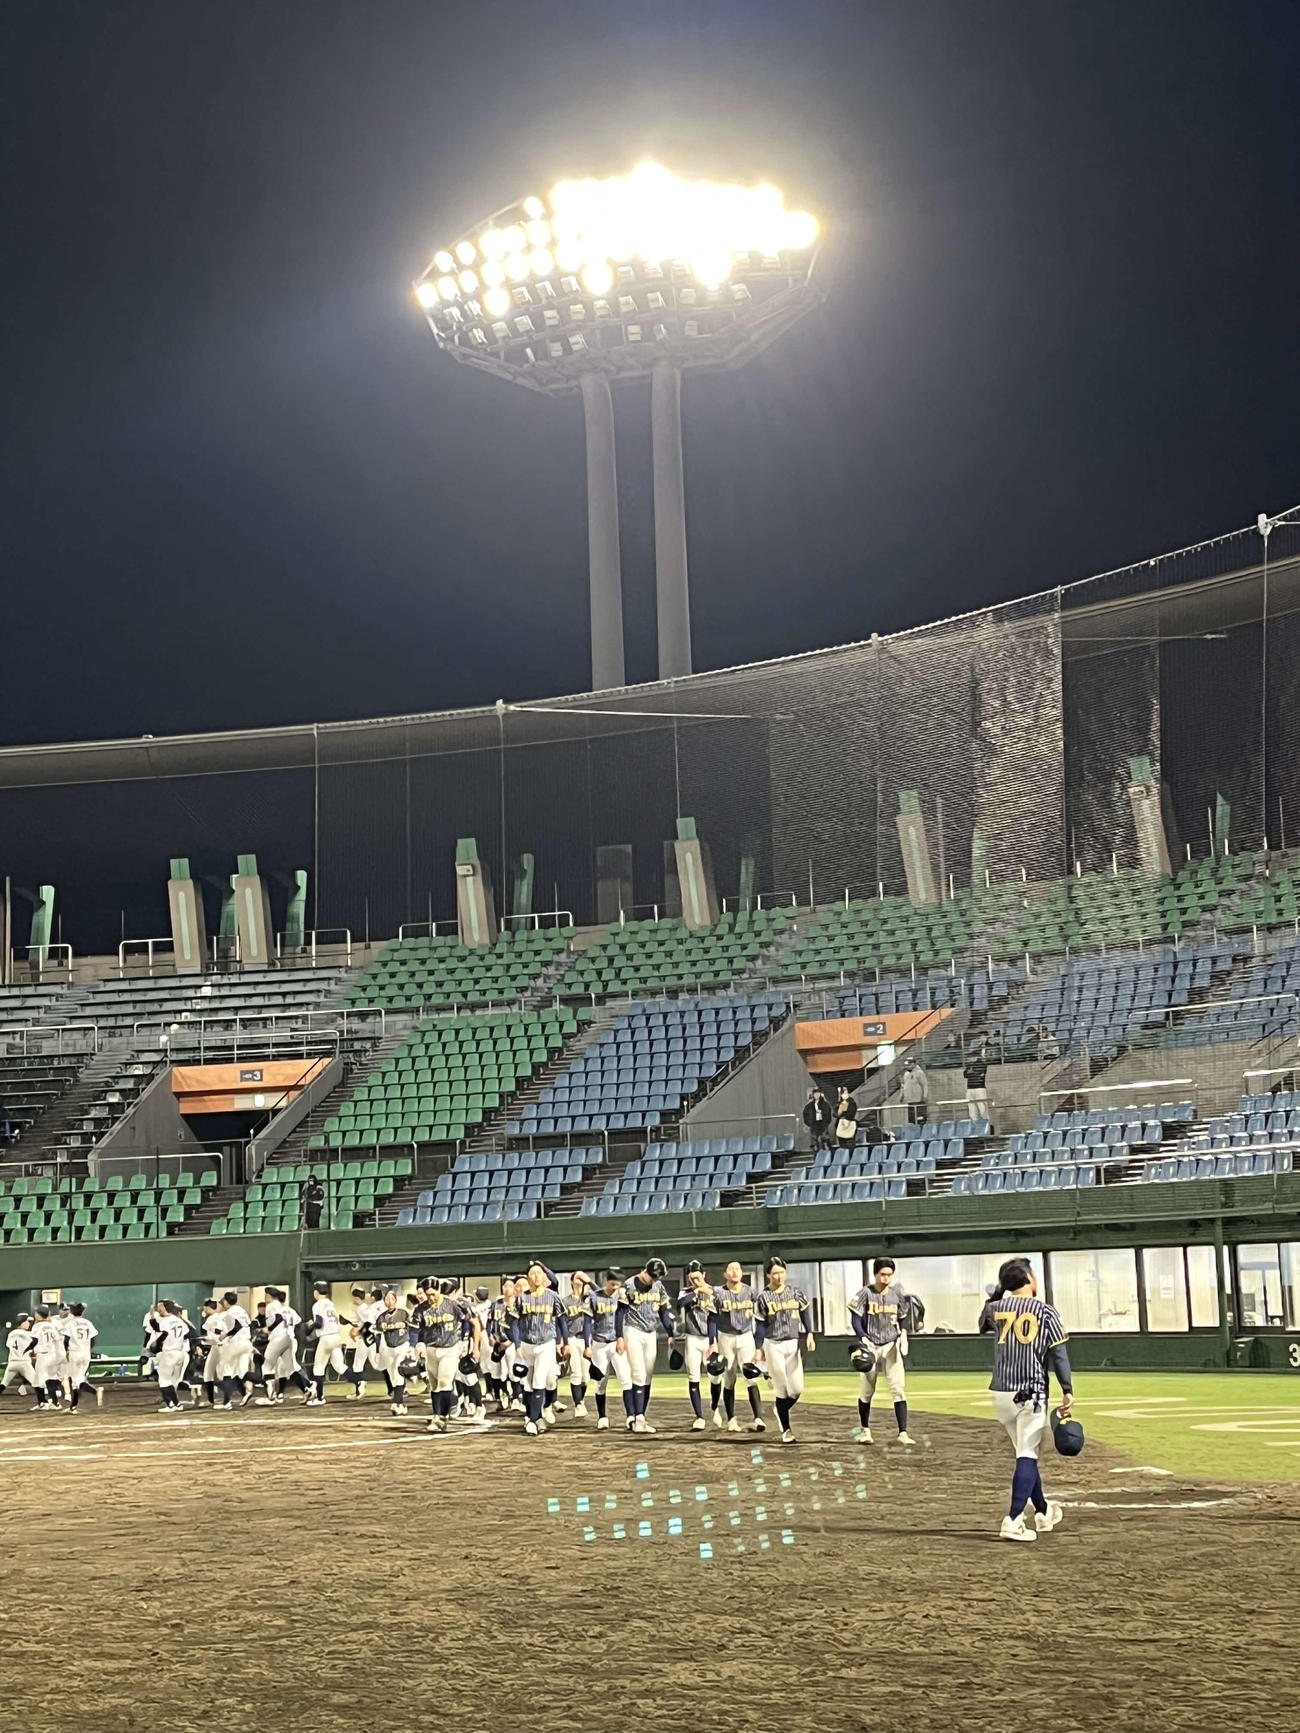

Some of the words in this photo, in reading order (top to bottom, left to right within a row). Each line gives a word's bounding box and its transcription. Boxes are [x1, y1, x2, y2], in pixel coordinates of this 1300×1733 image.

[876, 1024, 884, 1034] 2
[253, 1071, 261, 1080] 3
[172, 1326, 183, 1338] 17
[993, 1310, 1039, 1344] 70
[77, 1328, 89, 1339] 51
[1289, 1343, 1300, 1367] 3
